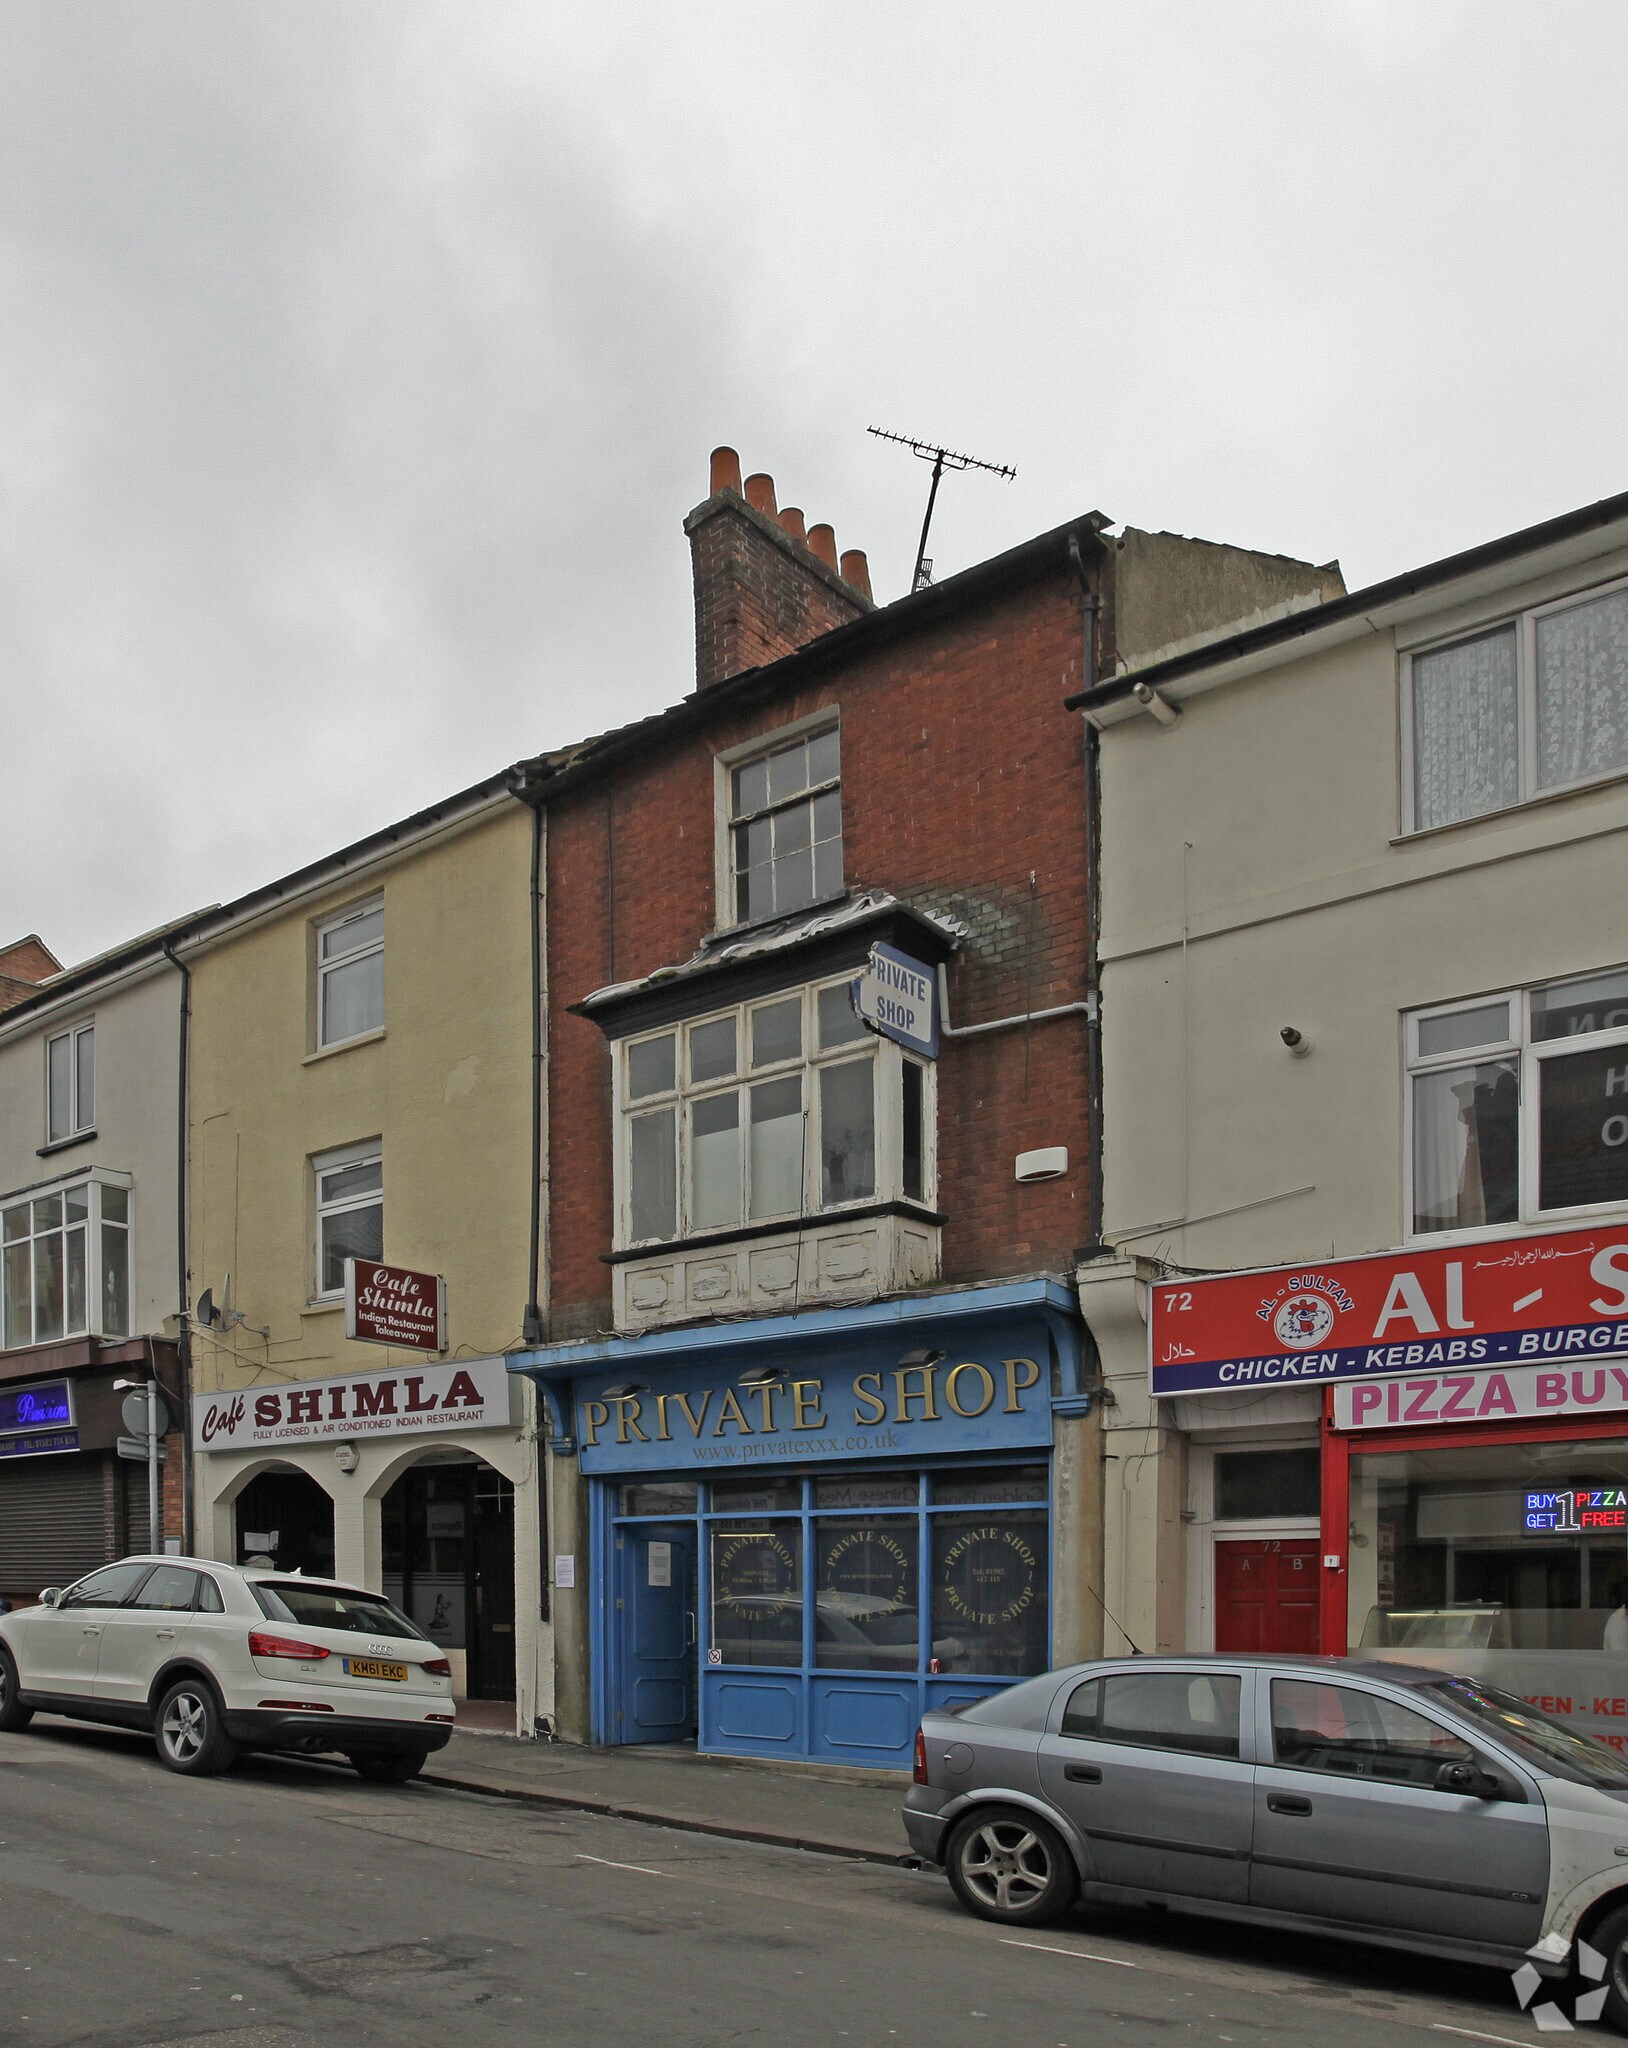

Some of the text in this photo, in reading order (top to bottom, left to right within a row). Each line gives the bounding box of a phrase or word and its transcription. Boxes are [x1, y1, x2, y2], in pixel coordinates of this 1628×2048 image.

[877, 995, 915, 1030] SHOP
[373, 1269, 420, 1296] Cafe
[1256, 1298, 1277, 1322] AL
[1287, 1274, 1354, 1313] SULTAN
[358, 1287, 434, 1318] Shimla
[1164, 1292, 1192, 1313] 72
[1372, 1261, 1474, 1339] Al
[359, 1310, 434, 1332] Indian Restaurant
[375, 1324, 421, 1343] Takeaway
[1162, 1343, 1196, 1362] حلال
[1218, 1353, 1338, 1382] CHICKEN
[1365, 1338, 1488, 1368] KEBABS
[201, 1370, 485, 1443] Café SHIMLA
[582, 1358, 1040, 1445] PRIVATE SHOP
[1352, 1374, 1518, 1425] PIZZA
[253, 1410, 484, 1439] FULLY LICENSED & AIR CONDITIONED INDIAN RESTAURANT
[693, 1428, 898, 1463] www.privatexxx.co.uk
[1526, 1511, 1626, 1528] GET FREE
[1527, 1491, 1627, 1531] BUY 1 PIZZA
[721, 1536, 794, 1568] PRIVATE SHOP
[827, 1531, 908, 1567] PRIVATE SHOP
[944, 1527, 1036, 1566] PRIVATE SHOP
[1262, 1541, 1281, 1553] 72
[1242, 1559, 1250, 1571] A
[1293, 1558, 1303, 1570] B
[878, 1585, 907, 1618] SHOP
[944, 1586, 1034, 1625] PRIVATE SHOP
[353, 1662, 404, 1678] KM61 EKC
